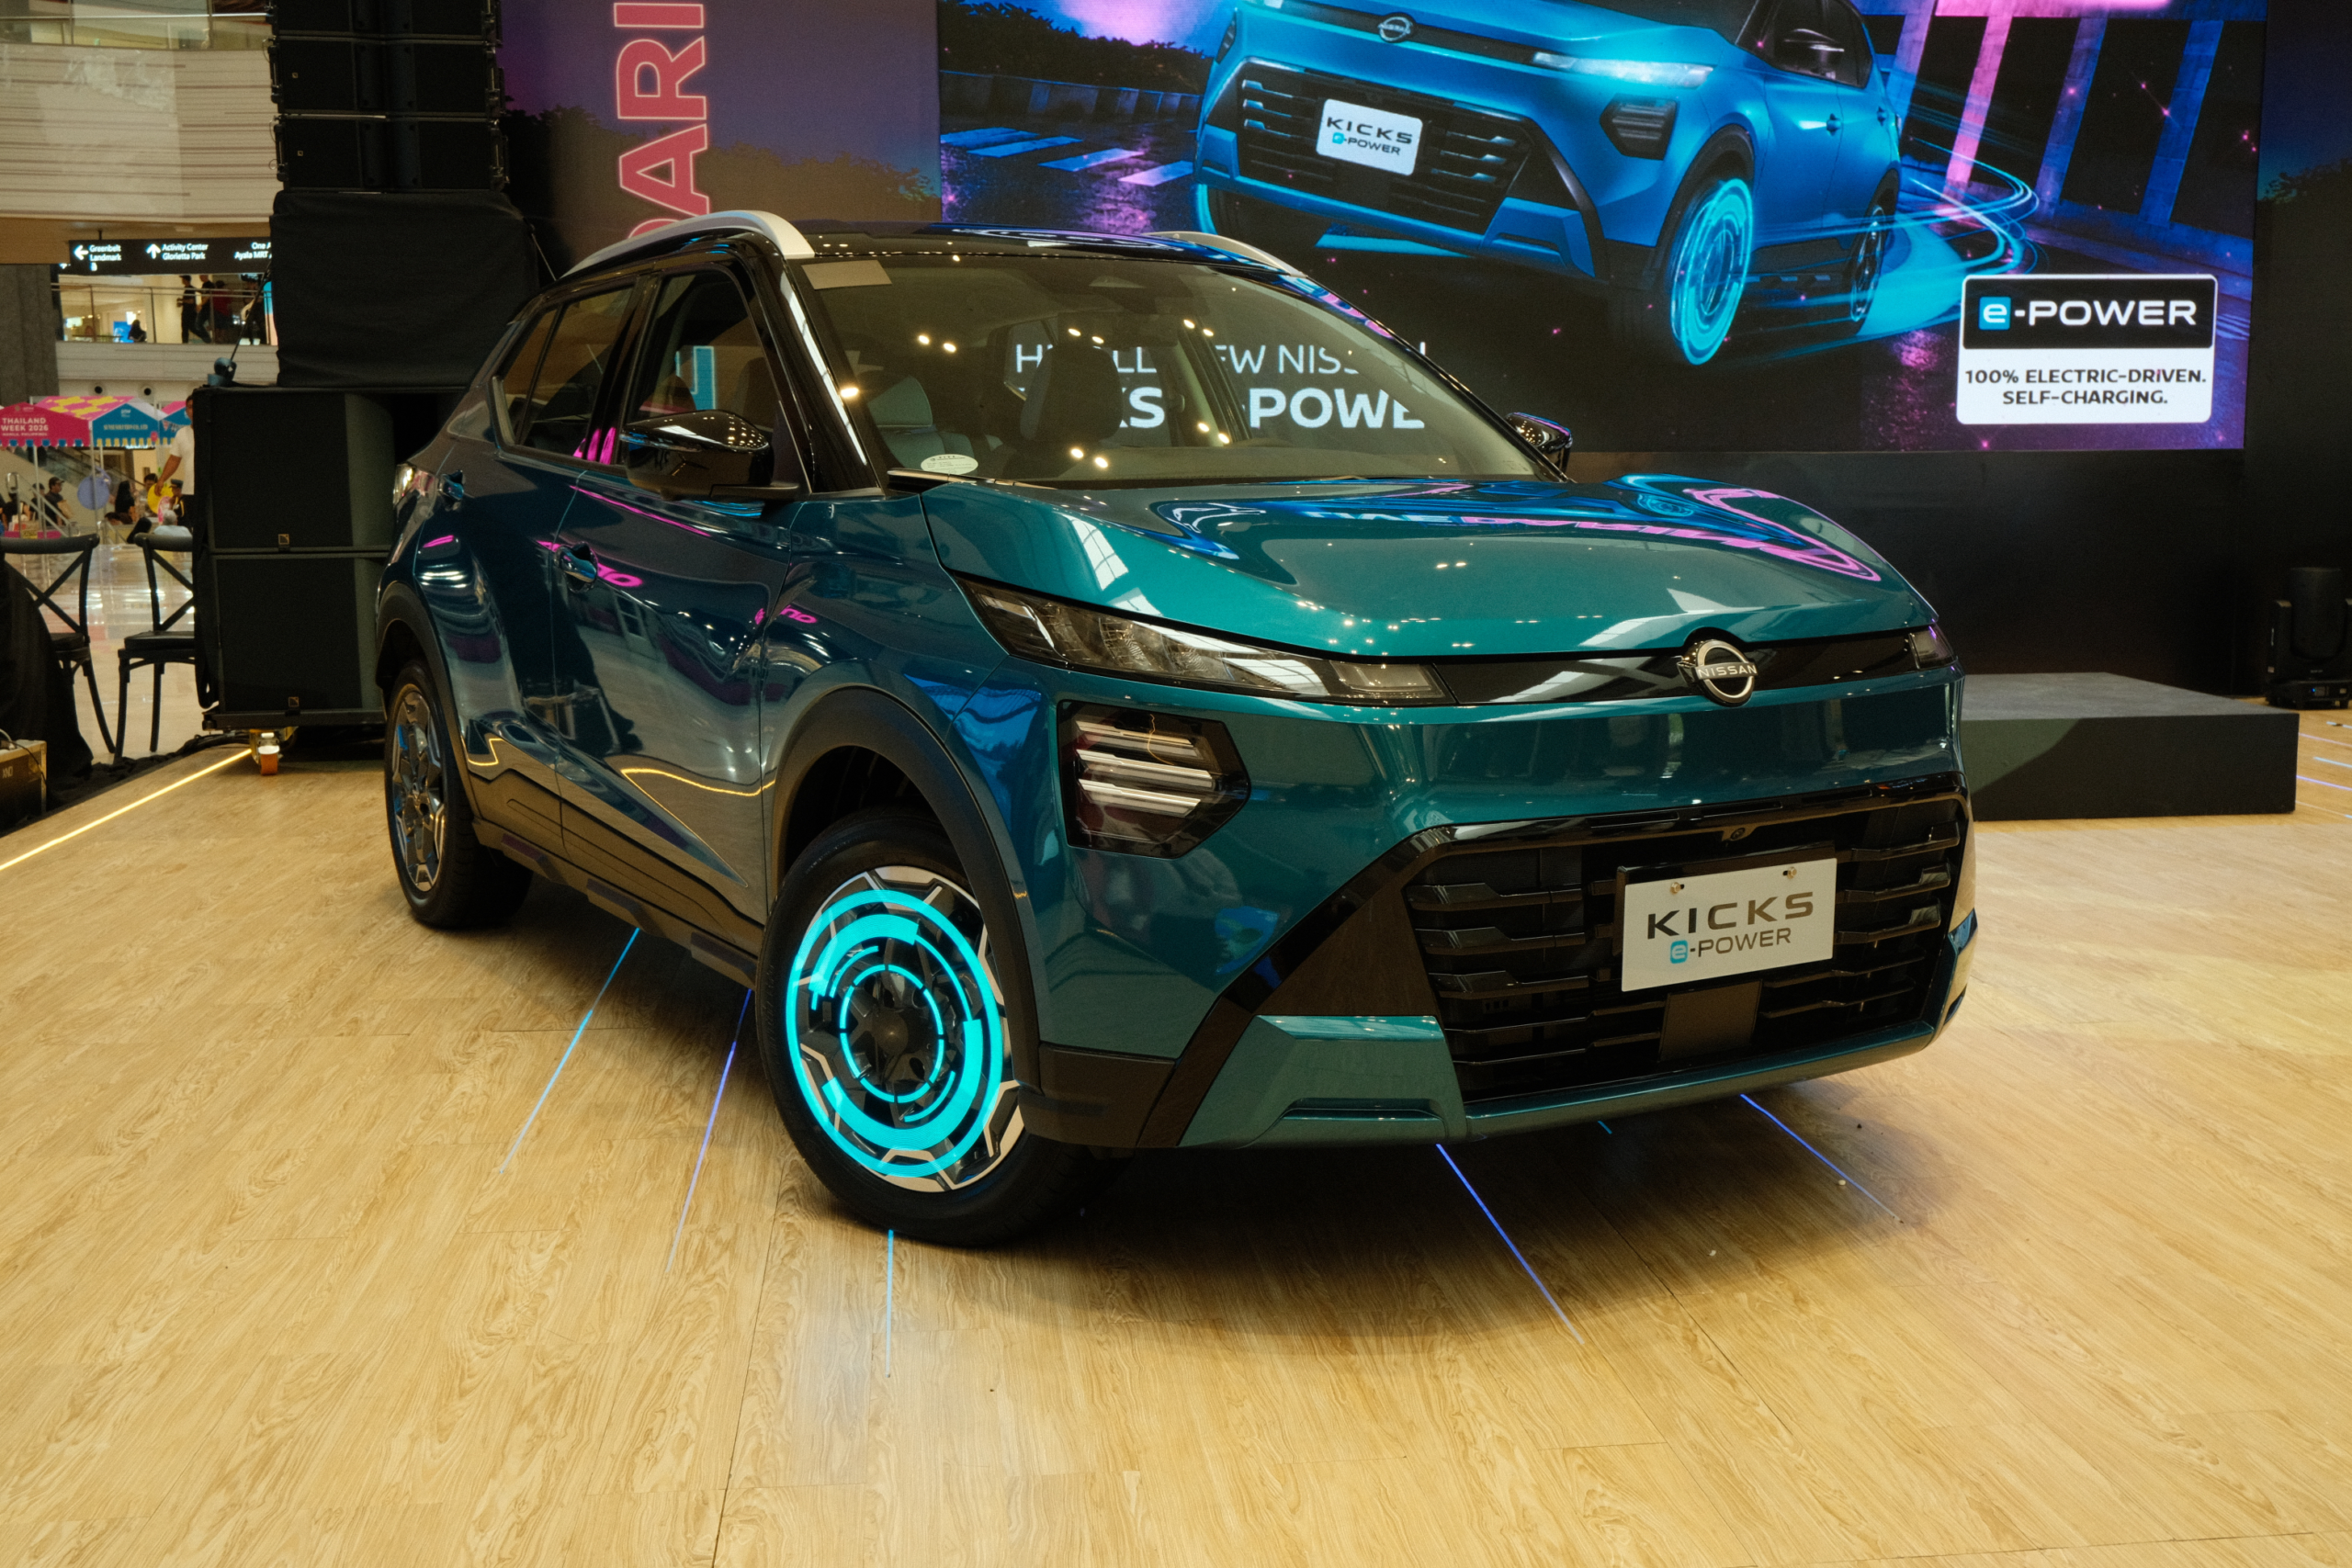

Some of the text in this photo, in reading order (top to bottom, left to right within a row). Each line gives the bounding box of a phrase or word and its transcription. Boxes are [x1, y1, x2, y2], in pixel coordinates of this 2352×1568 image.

[614, 2, 711, 239] ARI
[1327, 117, 1413, 144] KICKS
[1332, 132, 1401, 155] e-POWER
[88, 244, 121, 253] Greenbelt
[251, 242, 265, 250] One
[89, 254, 121, 262] Landmark
[190, 252, 206, 260] Park
[233, 251, 253, 261] Ayala
[253, 251, 268, 259] MRT
[1980, 299, 2198, 328] e-POWER
[1965, 368, 2207, 384] 100% ELECTRIC-DRIVEN.
[2003, 389, 2168, 405] SELF-CHARGING.
[1698, 664, 1758, 678] NISSAN
[1647, 891, 1814, 940] KICKS
[1670, 927, 1792, 964] e-POWER
